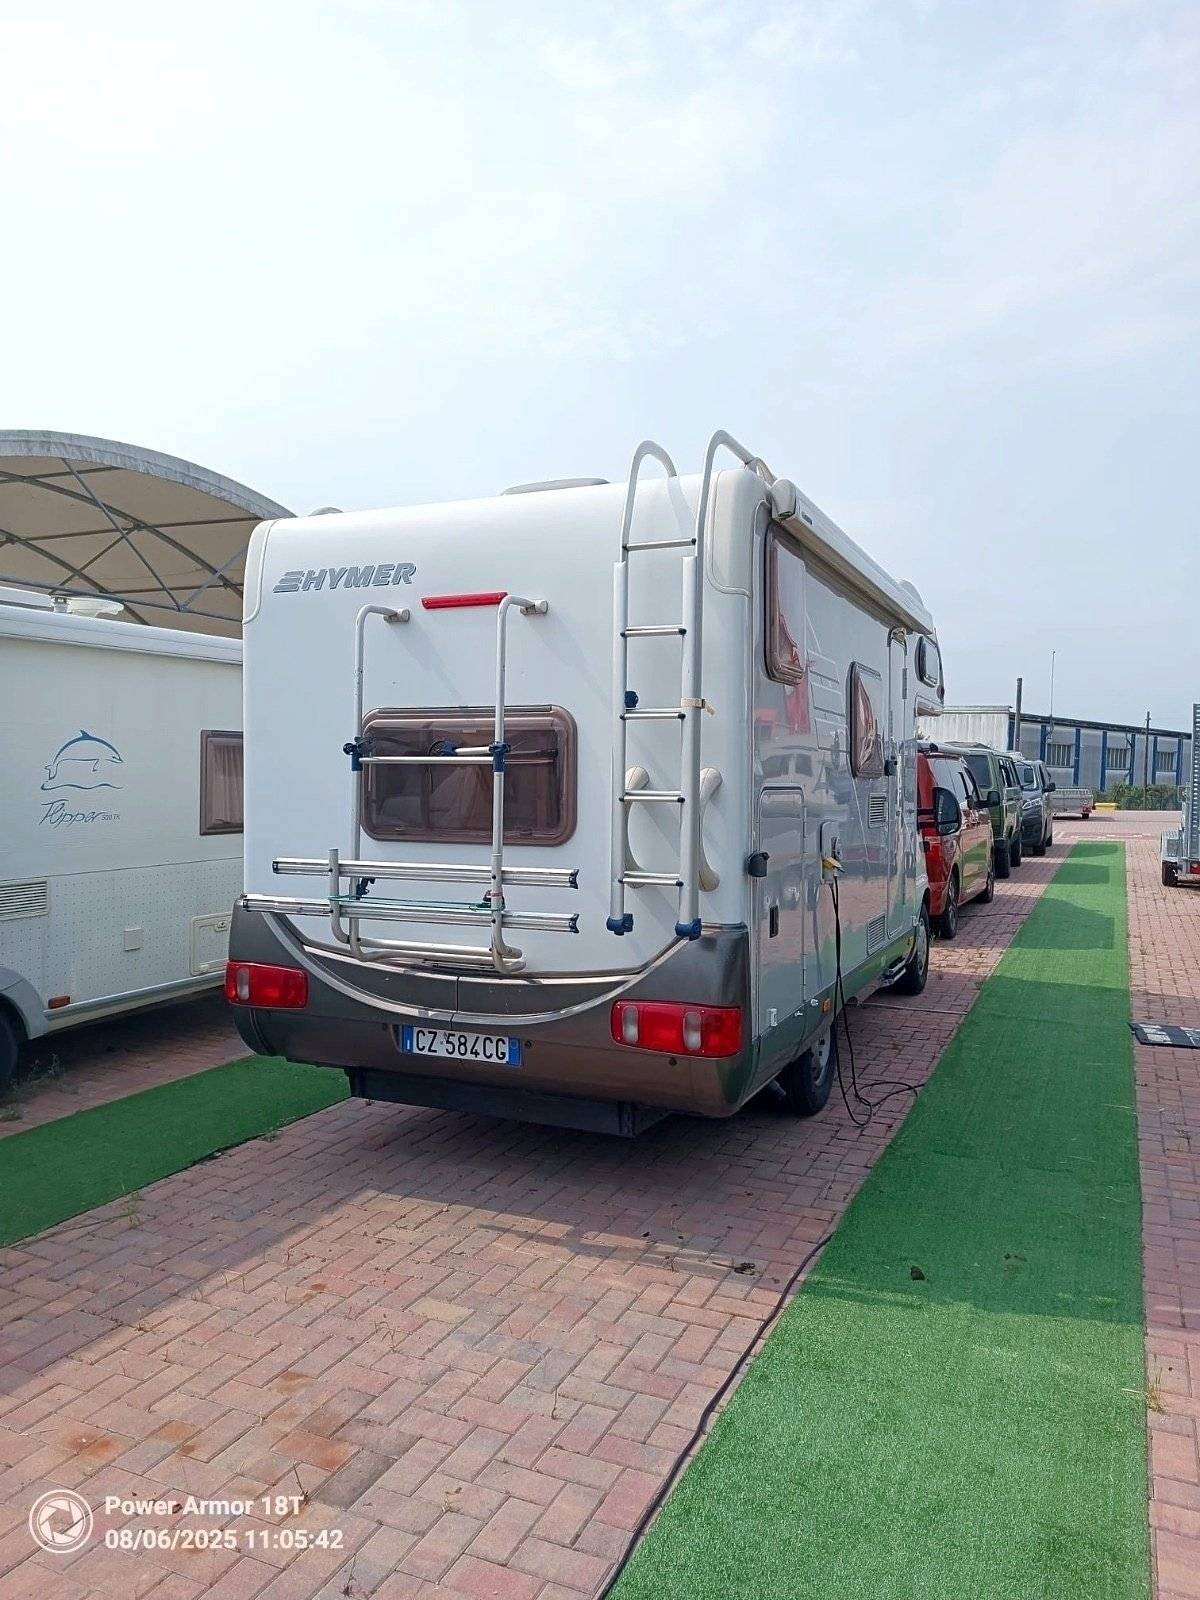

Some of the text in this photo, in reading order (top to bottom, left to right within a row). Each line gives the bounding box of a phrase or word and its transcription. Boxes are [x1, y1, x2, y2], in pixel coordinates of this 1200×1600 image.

[300, 562, 416, 592] HYMER
[38, 798, 108, 828] Flipper
[416, 1029, 506, 1060] CZ 584CG
